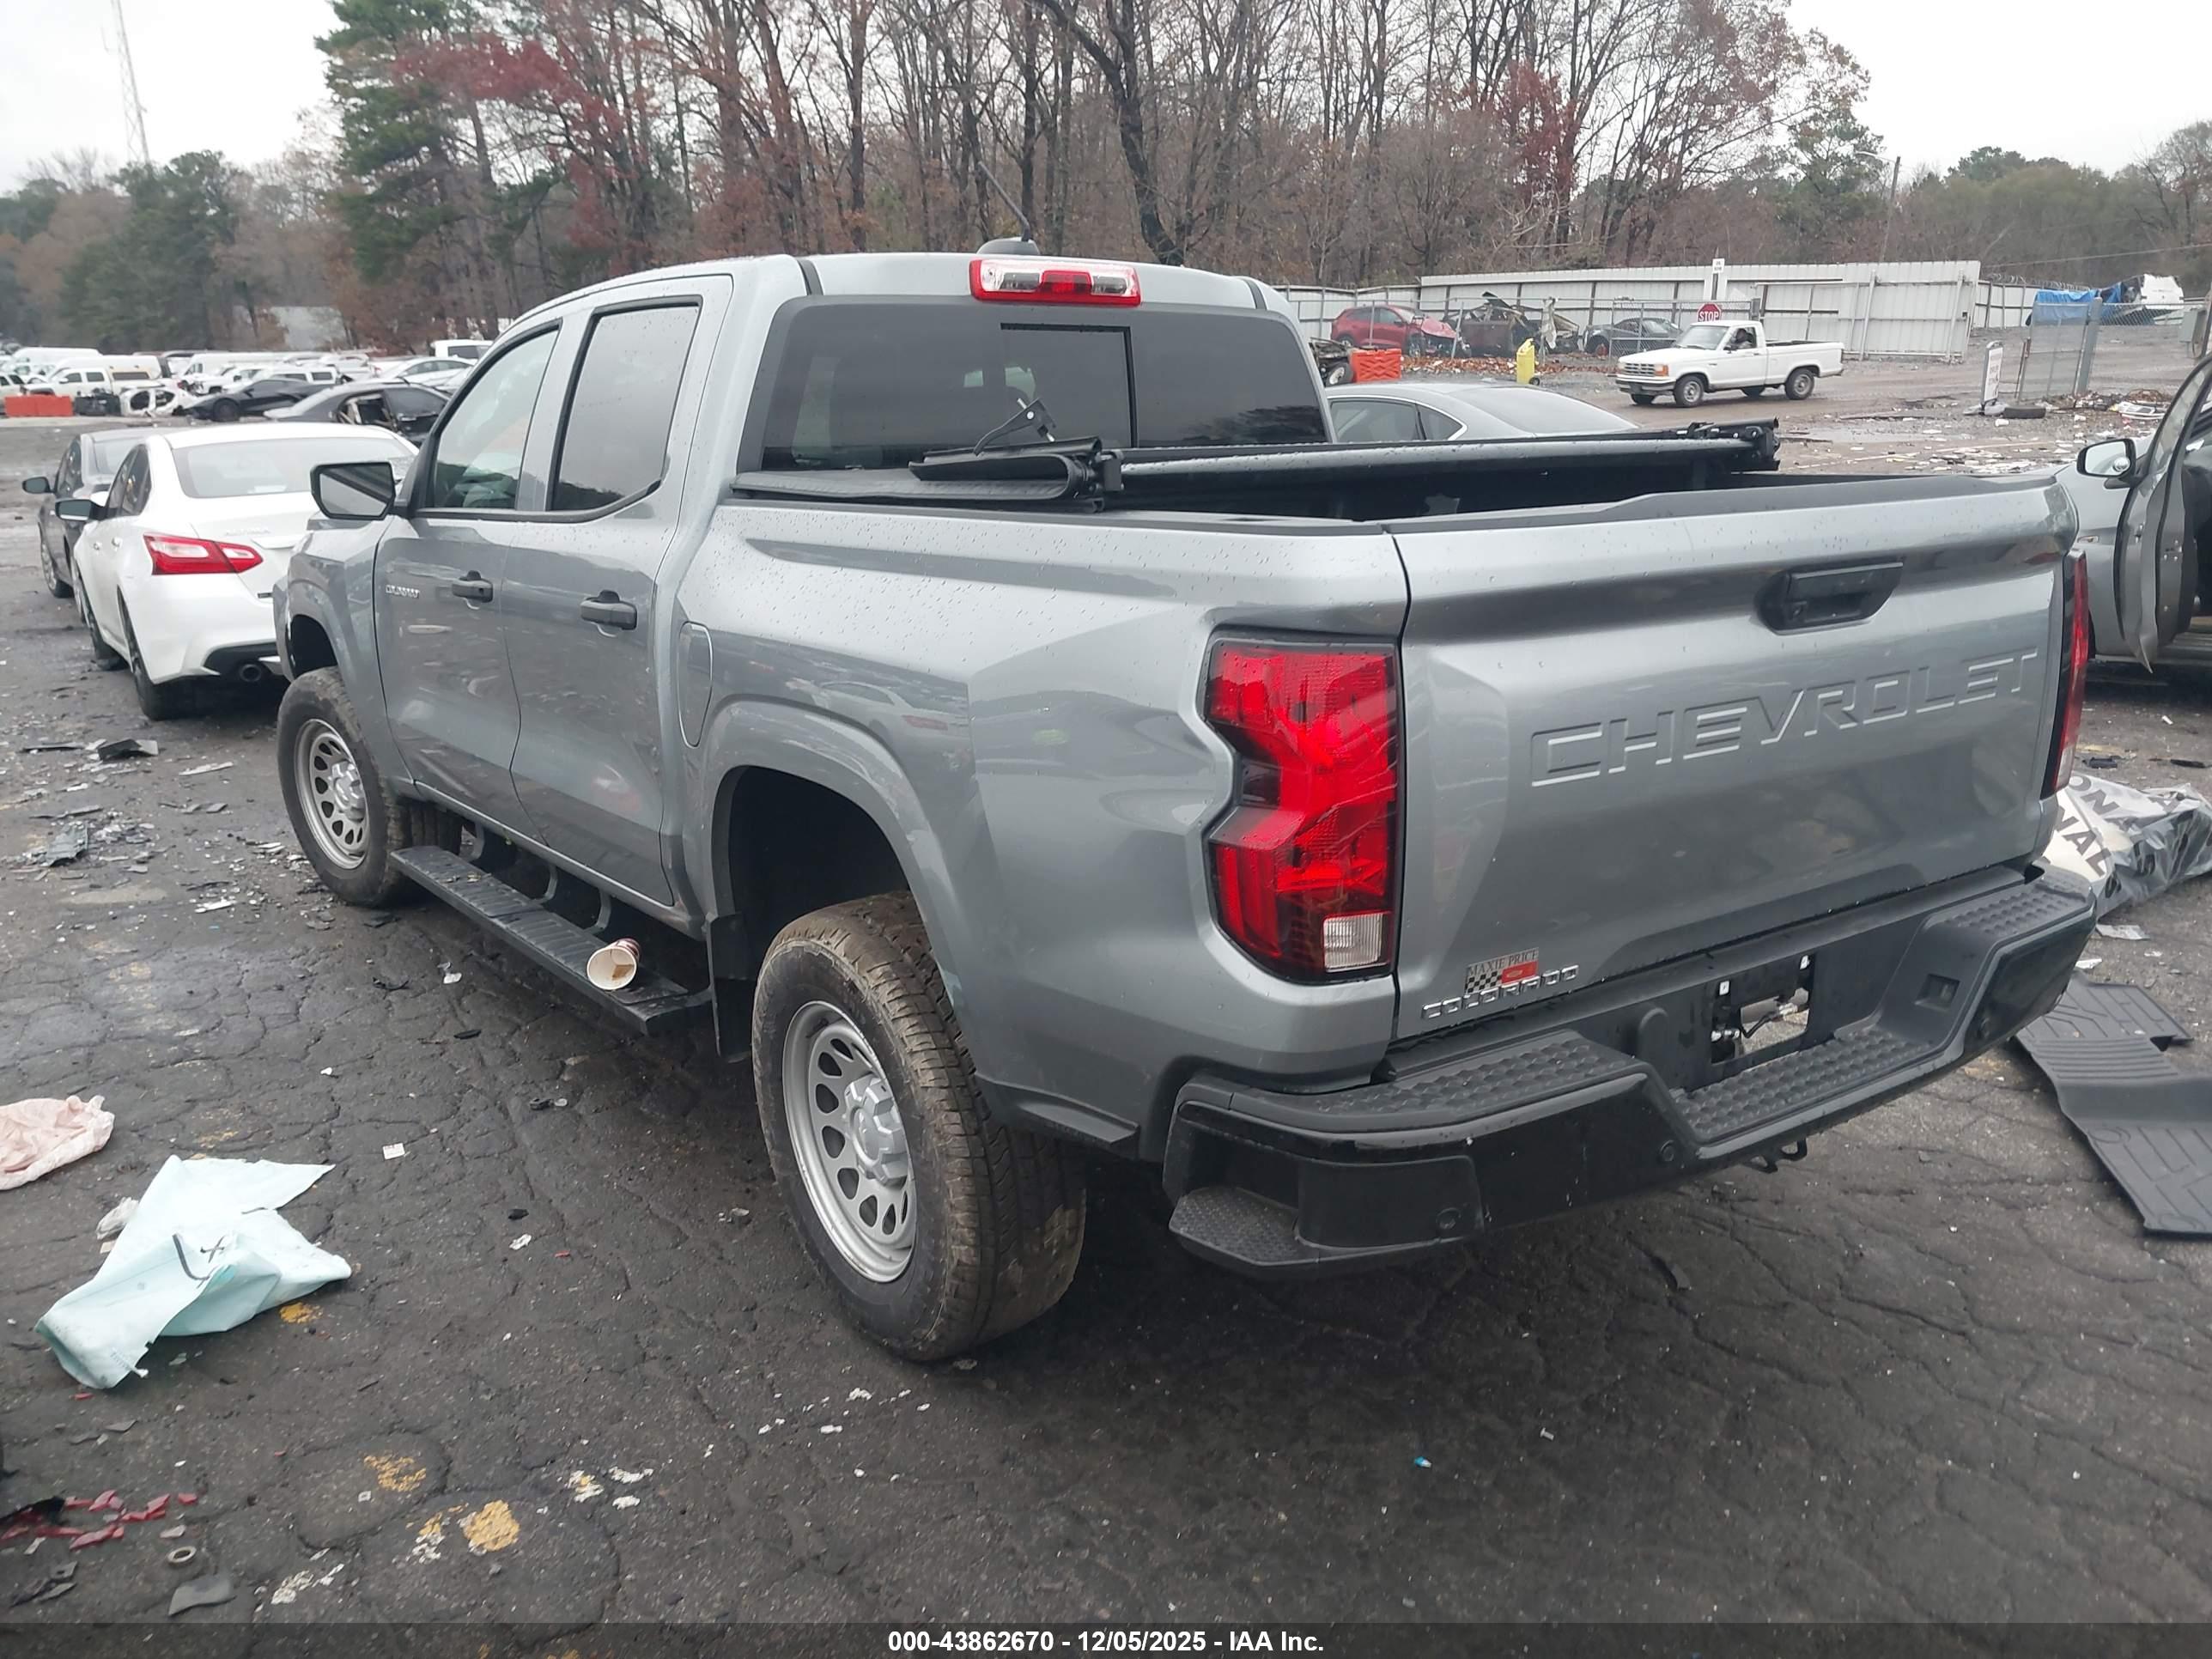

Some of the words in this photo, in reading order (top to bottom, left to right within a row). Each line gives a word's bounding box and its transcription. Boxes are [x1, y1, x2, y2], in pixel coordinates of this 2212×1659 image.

[1699, 311, 1719, 321] STOP
[1531, 647, 2039, 787] CHEVROLET
[1468, 957, 1506, 977] MAXIE
[1509, 949, 1539, 966] PRICE
[1421, 964, 1580, 1019] COLORADO
